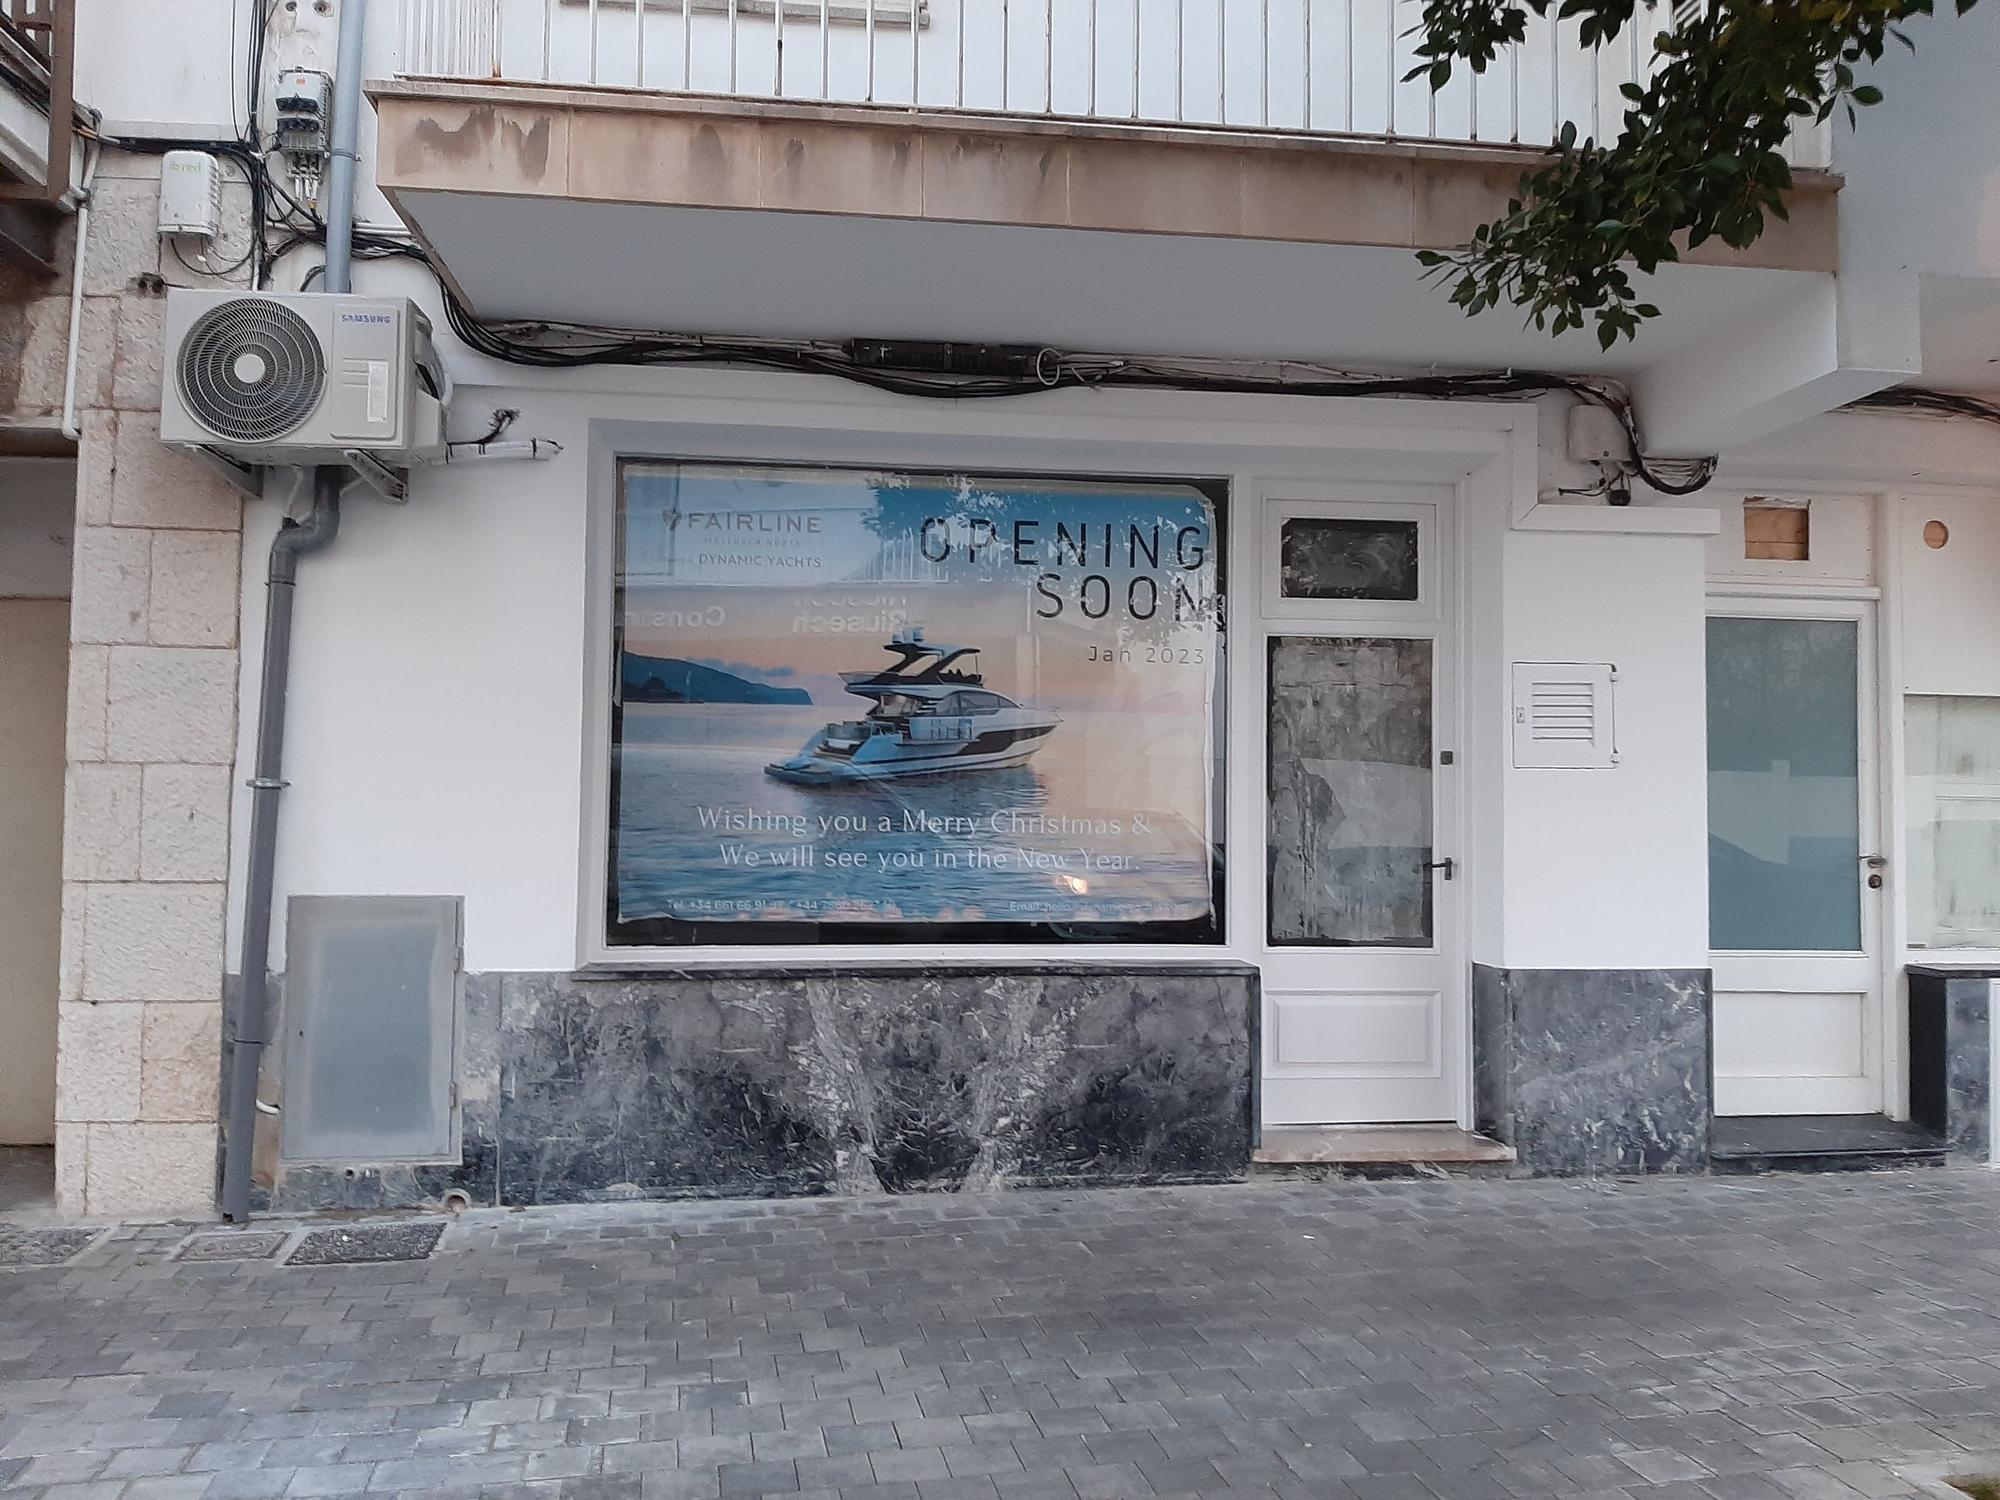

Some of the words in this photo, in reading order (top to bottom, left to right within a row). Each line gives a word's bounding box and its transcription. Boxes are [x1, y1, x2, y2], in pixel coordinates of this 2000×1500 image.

[341, 314, 391, 323] SAMSUNG
[688, 511, 822, 533] FAIRLINE
[919, 517, 1205, 571] OPENING
[699, 553, 763, 567] DYNAMIC
[767, 555, 822, 568] YACHTS
[1036, 573, 1204, 622] SOON
[1087, 645, 1132, 663] Jan
[1145, 647, 1205, 665] 2023
[696, 806, 807, 838] Wishing
[817, 814, 867, 838] you
[877, 815, 892, 832] a
[902, 808, 980, 839] Merry
[990, 810, 1122, 835] Christmas
[1131, 812, 1153, 834] &
[719, 843, 760, 867] We
[770, 844, 814, 867] will
[824, 850, 868, 868] see
[877, 851, 925, 874] you
[934, 848, 957, 868] in
[968, 847, 1008, 869] the
[1016, 848, 1070, 869] New
[1079, 847, 1140, 871] Year.
